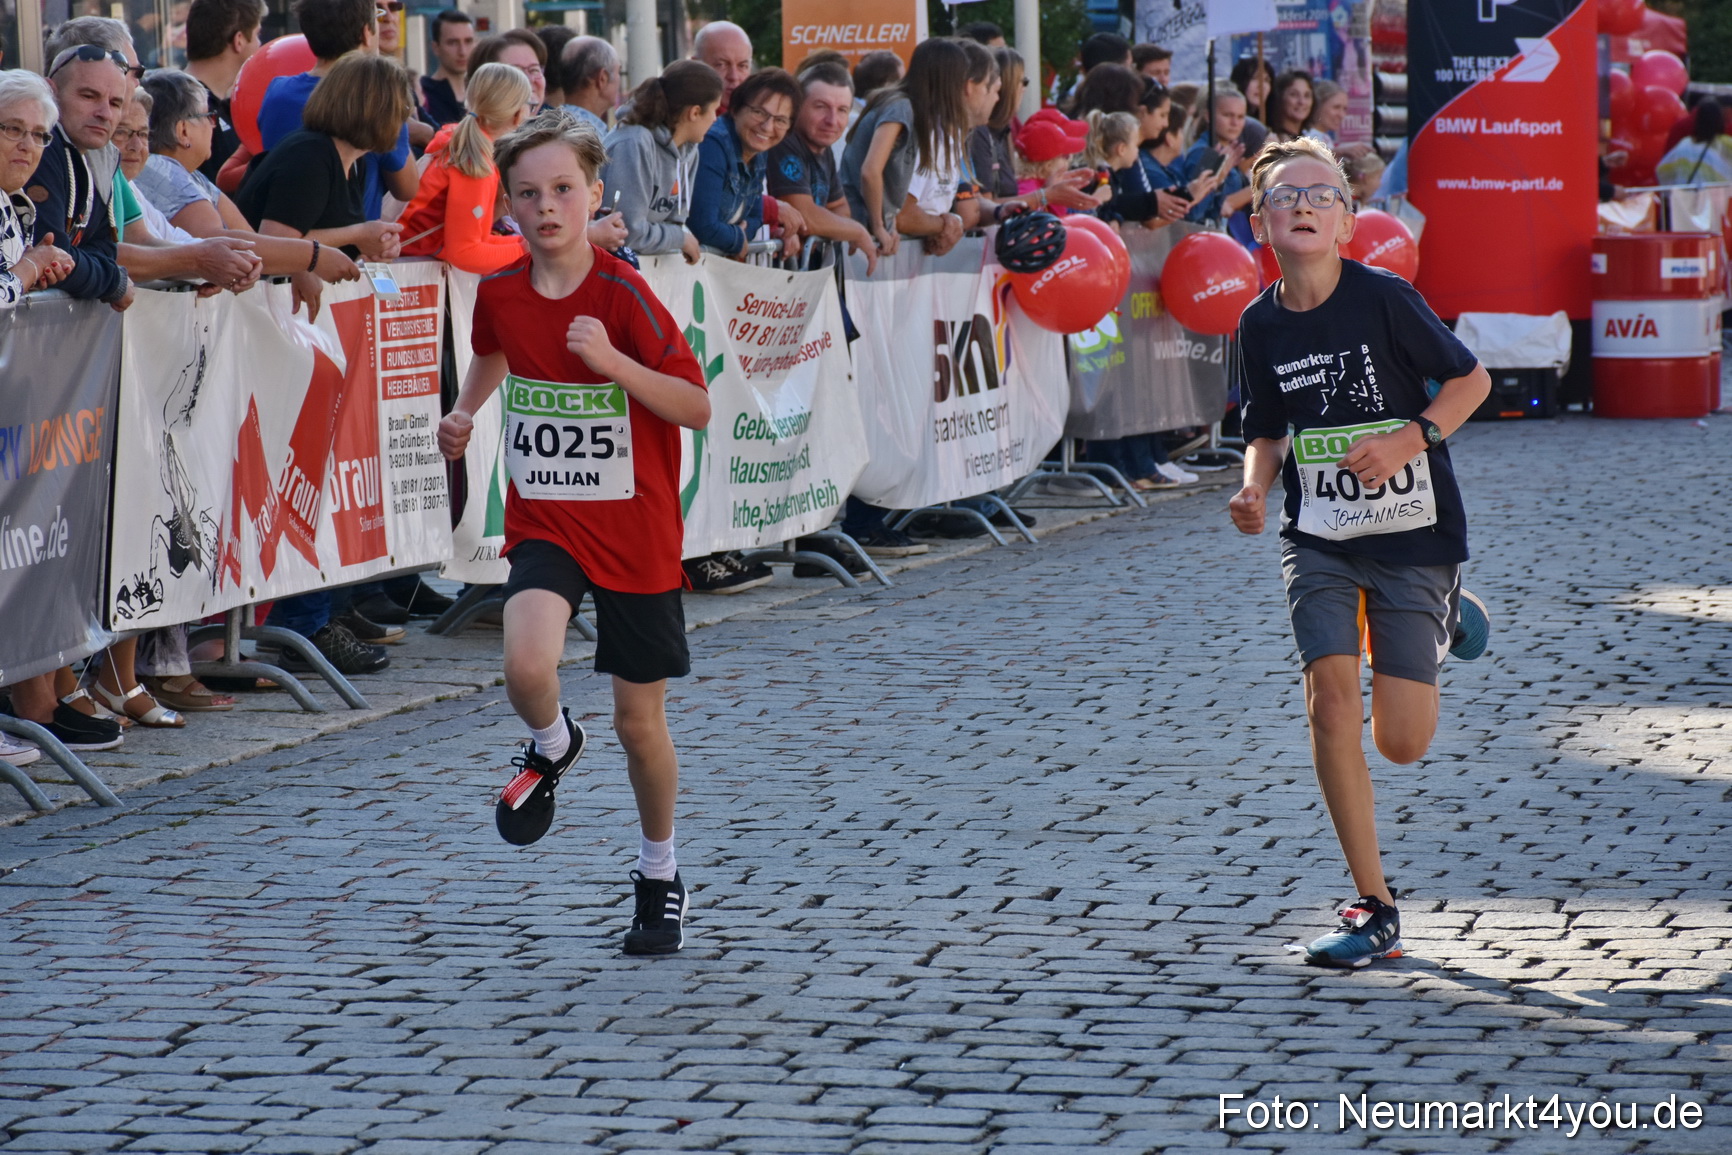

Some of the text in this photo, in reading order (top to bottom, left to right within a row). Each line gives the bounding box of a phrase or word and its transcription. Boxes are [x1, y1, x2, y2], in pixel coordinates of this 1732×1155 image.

[789, 23, 911, 44] SCHNELLER!
[1452, 56, 1510, 69] THE NEXT
[1435, 70, 1496, 82] 100 YEARS
[1435, 118, 1562, 137] BMW Laufsport
[1361, 344, 1385, 412] BAMBINI
[512, 383, 617, 415] BOCK
[388, 416, 408, 431] Braun
[389, 434, 398, 450] Am
[400, 432, 431, 449] Grünberg
[513, 421, 616, 460] 4025
[525, 470, 600, 486] JULIAN
[1324, 500, 1424, 532] JOHANNES
